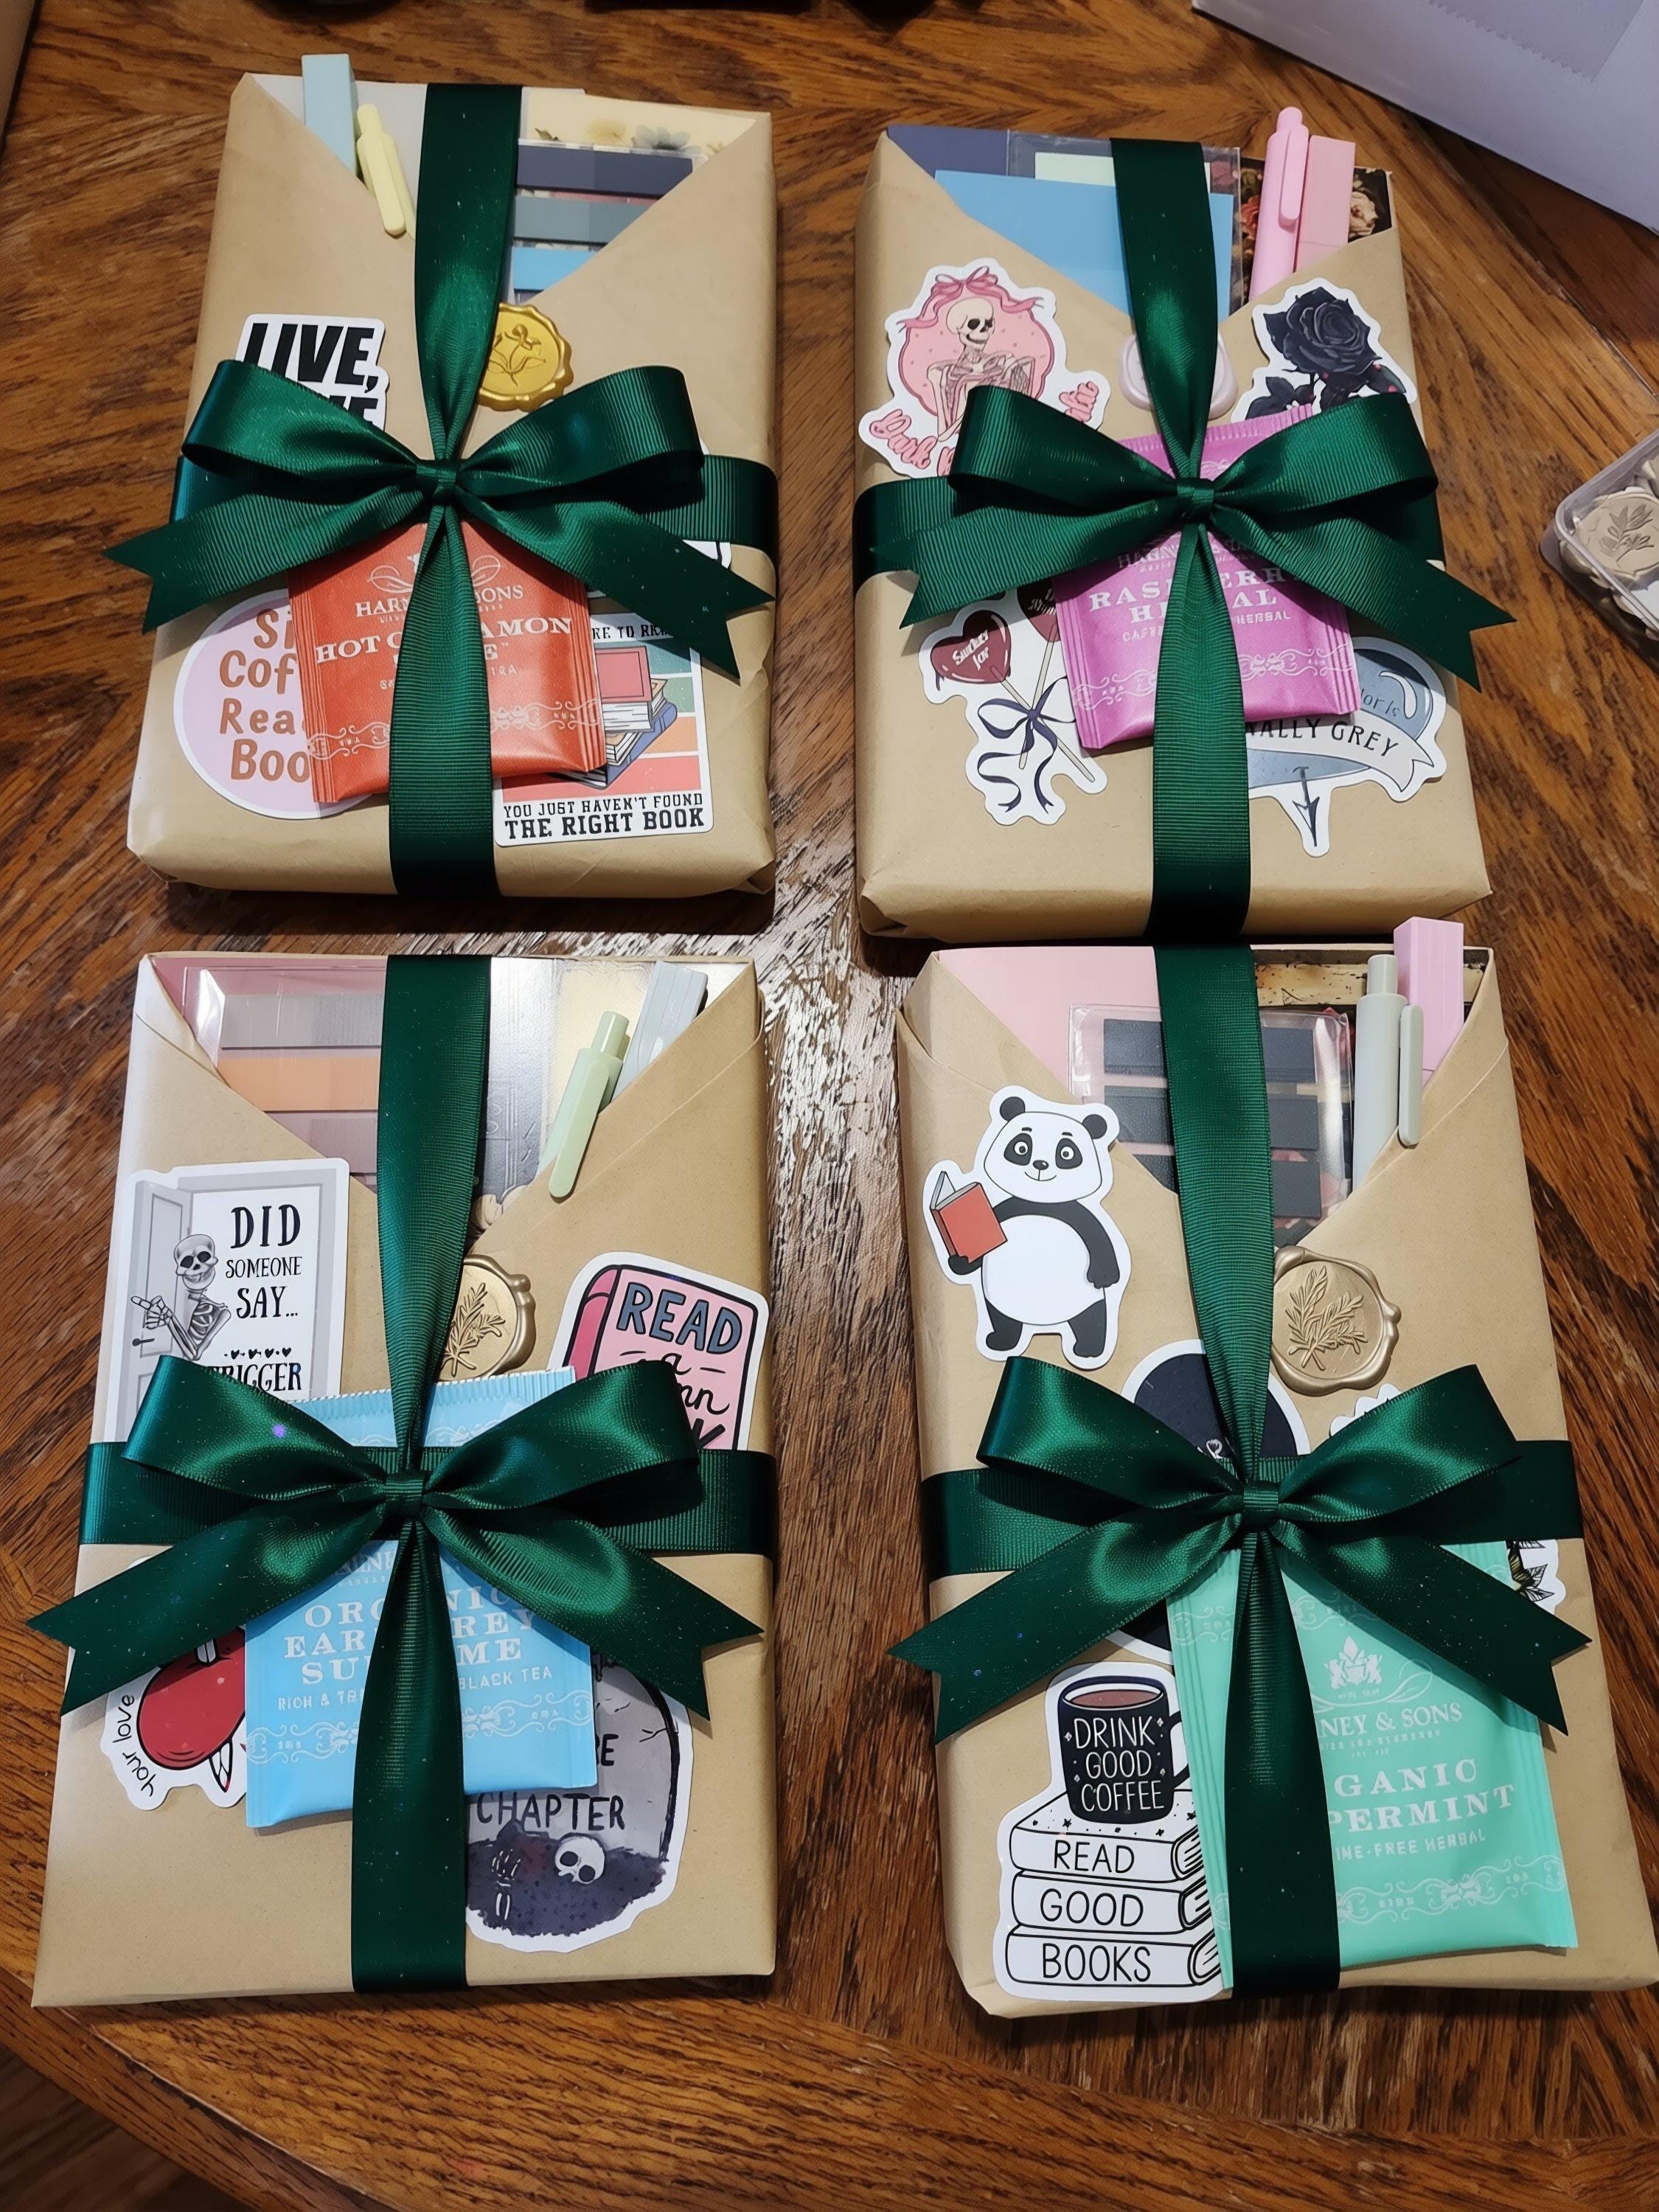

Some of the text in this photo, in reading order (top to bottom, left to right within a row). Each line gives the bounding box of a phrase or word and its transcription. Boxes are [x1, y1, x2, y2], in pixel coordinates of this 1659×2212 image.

[254, 608, 294, 650] Si
[316, 636, 380, 664] HOT
[220, 650, 297, 695] Cof
[220, 698, 305, 734] Rea
[1332, 721, 1399, 757] GREY
[230, 739, 310, 783] Boo
[504, 793, 703, 818] YOU JUST HAVEN'T FOUND
[504, 807, 704, 839] THE RIGHT BOOK
[230, 1204, 301, 1248] DID
[226, 1256, 302, 1278] SOMEONE
[616, 1281, 742, 1354] READ
[661, 1352, 692, 1376] a
[284, 1608, 534, 1658] EAR REY
[459, 1671, 512, 1689] BLACK
[521, 1666, 553, 1682] TEA
[1074, 1716, 1155, 1749] DRINK
[1318, 1703, 1462, 1738] NEY & SONS
[112, 1694, 156, 1798] your love
[1085, 1750, 1152, 1779] GOOD
[1334, 1759, 1477, 1797] GANIC
[476, 1792, 625, 1831] CHAPTER
[1081, 1780, 1164, 1812] COFFEE
[1329, 1784, 1514, 1833] PERMINT
[1053, 1839, 1135, 1874] READ
[1425, 1829, 1486, 1851] HERBAL
[1040, 1888, 1144, 1928] GOOD
[1042, 1942, 1152, 1983] BOOKS
